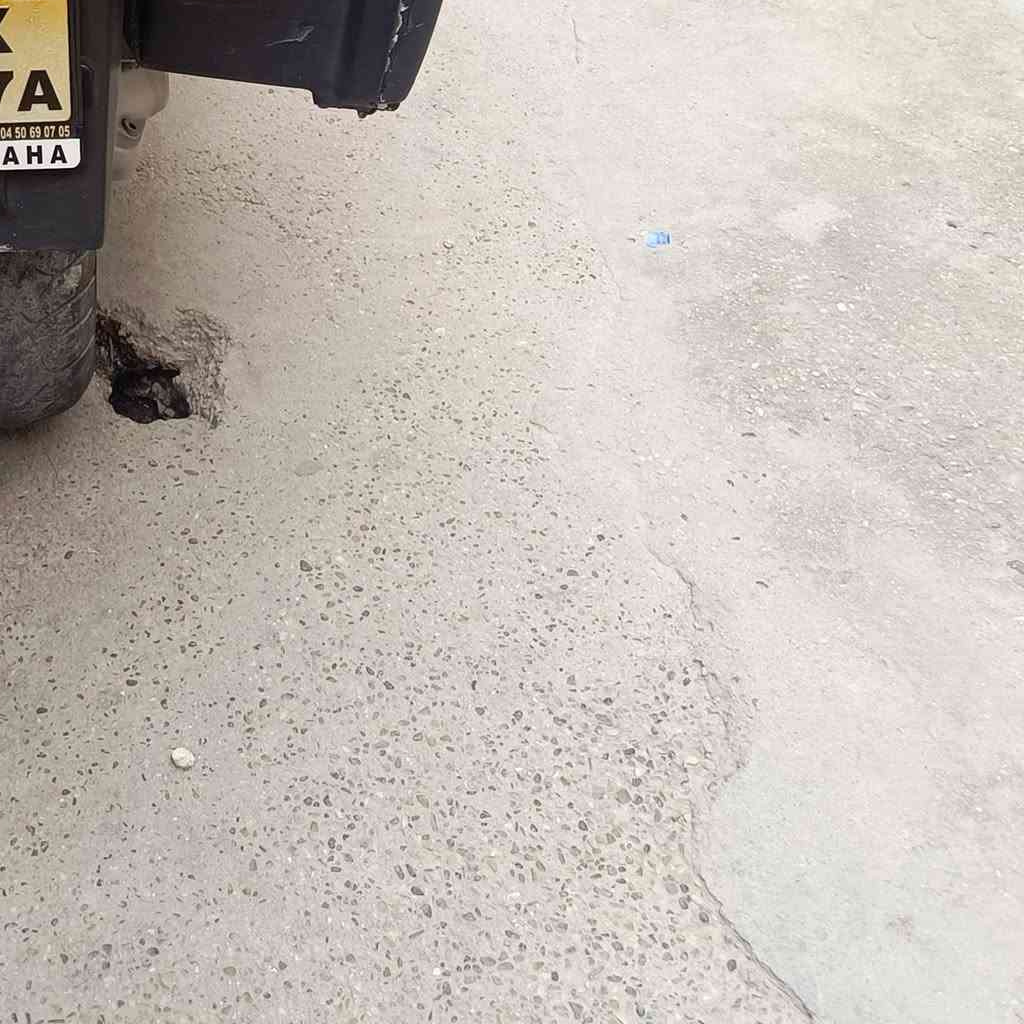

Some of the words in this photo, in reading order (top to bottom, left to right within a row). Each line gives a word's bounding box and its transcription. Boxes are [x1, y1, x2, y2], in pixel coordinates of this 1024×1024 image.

[0, 127, 13, 138] 04
[15, 126, 27, 139] 50
[29, 125, 42, 138] 69
[43, 125, 56, 138] 07
[58, 125, 71, 137] 05
